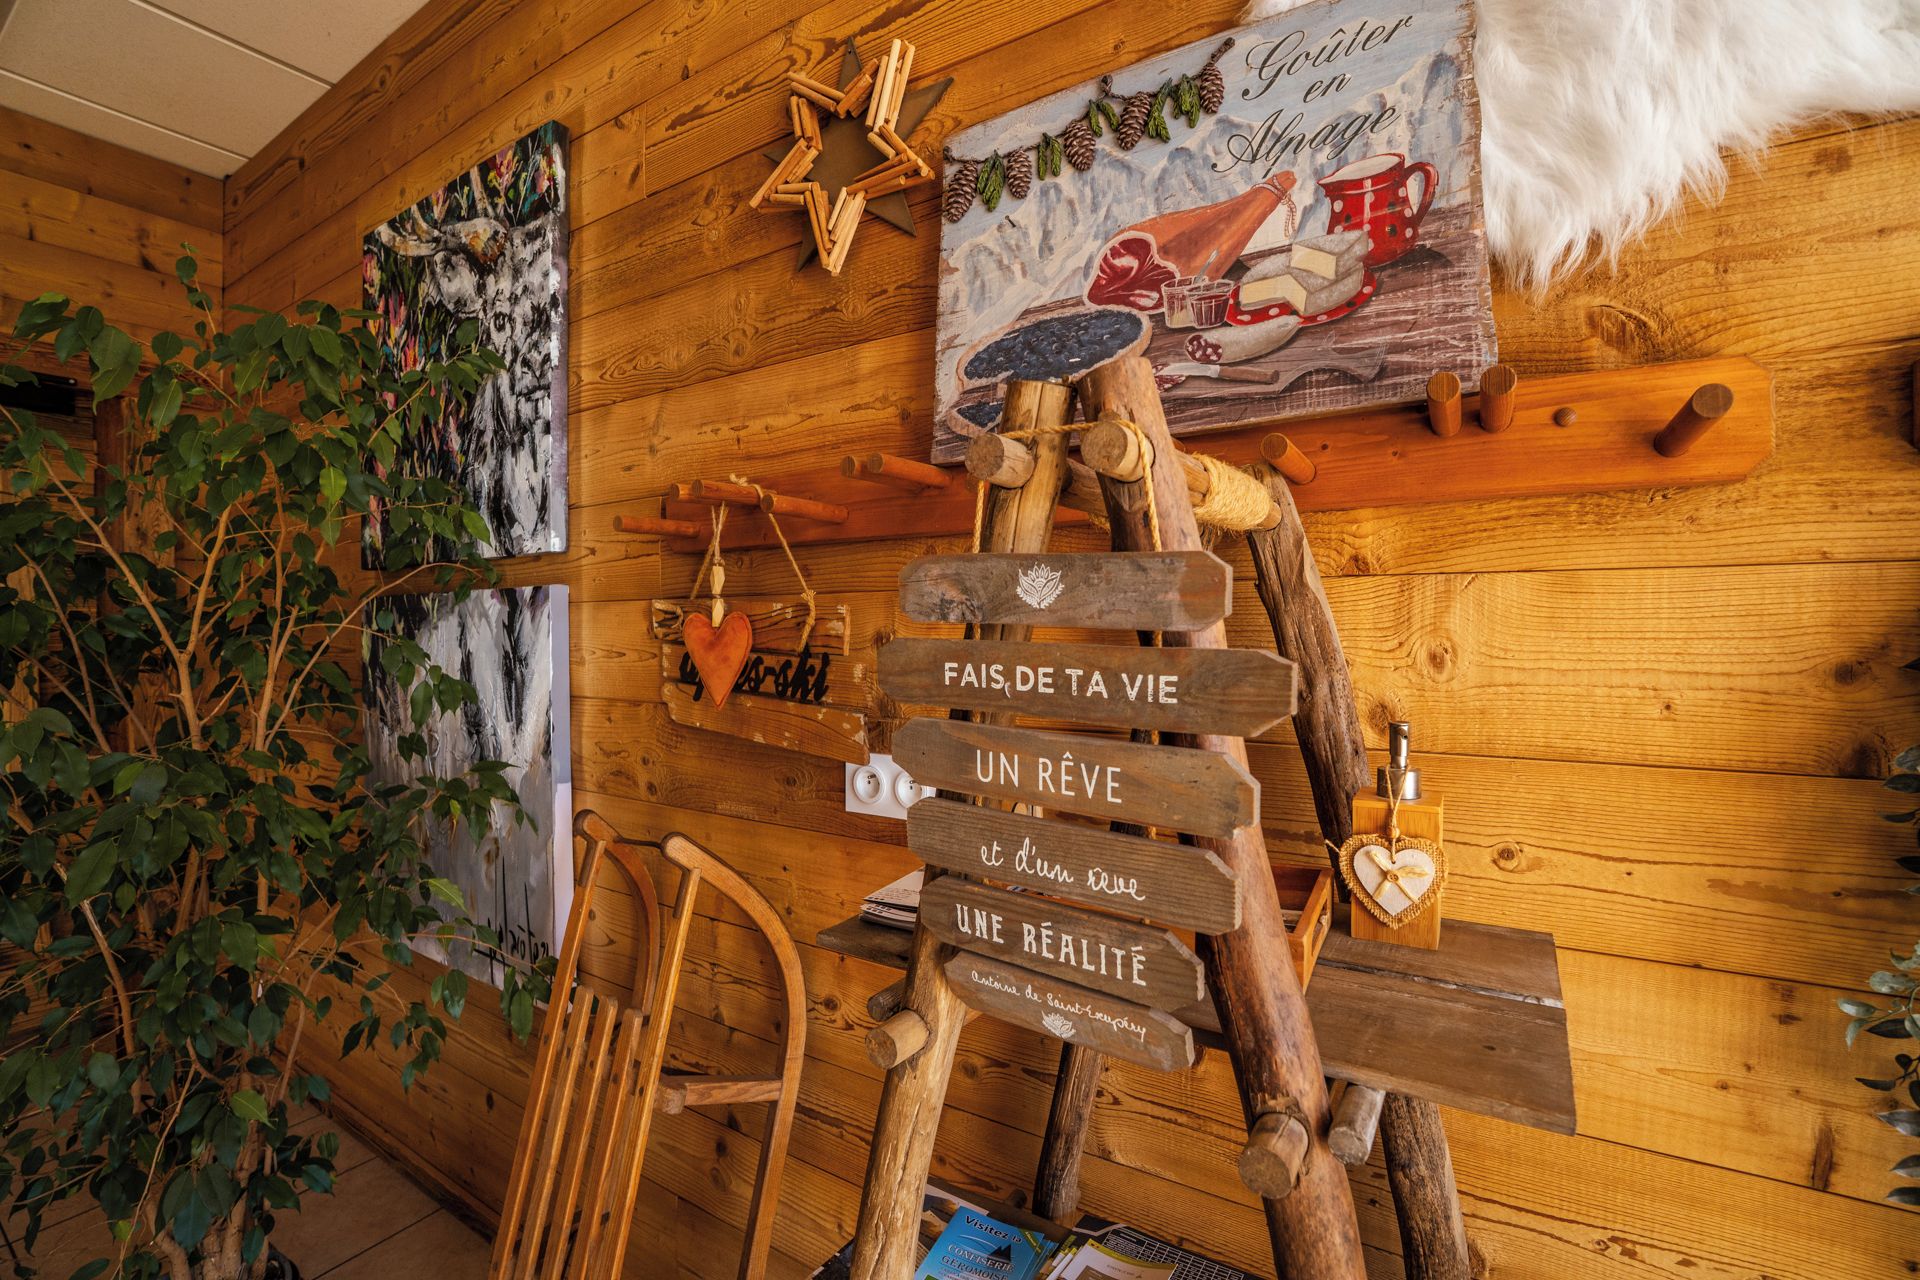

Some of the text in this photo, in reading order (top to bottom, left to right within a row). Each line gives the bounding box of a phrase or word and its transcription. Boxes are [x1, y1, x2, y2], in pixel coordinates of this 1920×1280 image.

[1242, 15, 1413, 101] Goûter
[1303, 73, 1351, 103] en
[1211, 105, 1401, 179] Alpage
[944, 662, 1179, 705] FAIS DE TA VIE
[976, 749, 1122, 804] UN RÊVE
[981, 836, 1146, 901] et d'un rêve
[955, 903, 1147, 986] UNE RÉALITÉ
[971, 970, 1147, 1042] Antoine de Saint-Exupéry
[947, 1243, 1015, 1273] CONFISERIE
[965, 1215, 1009, 1240] Visitez
[1012, 1235, 1022, 1244] la
